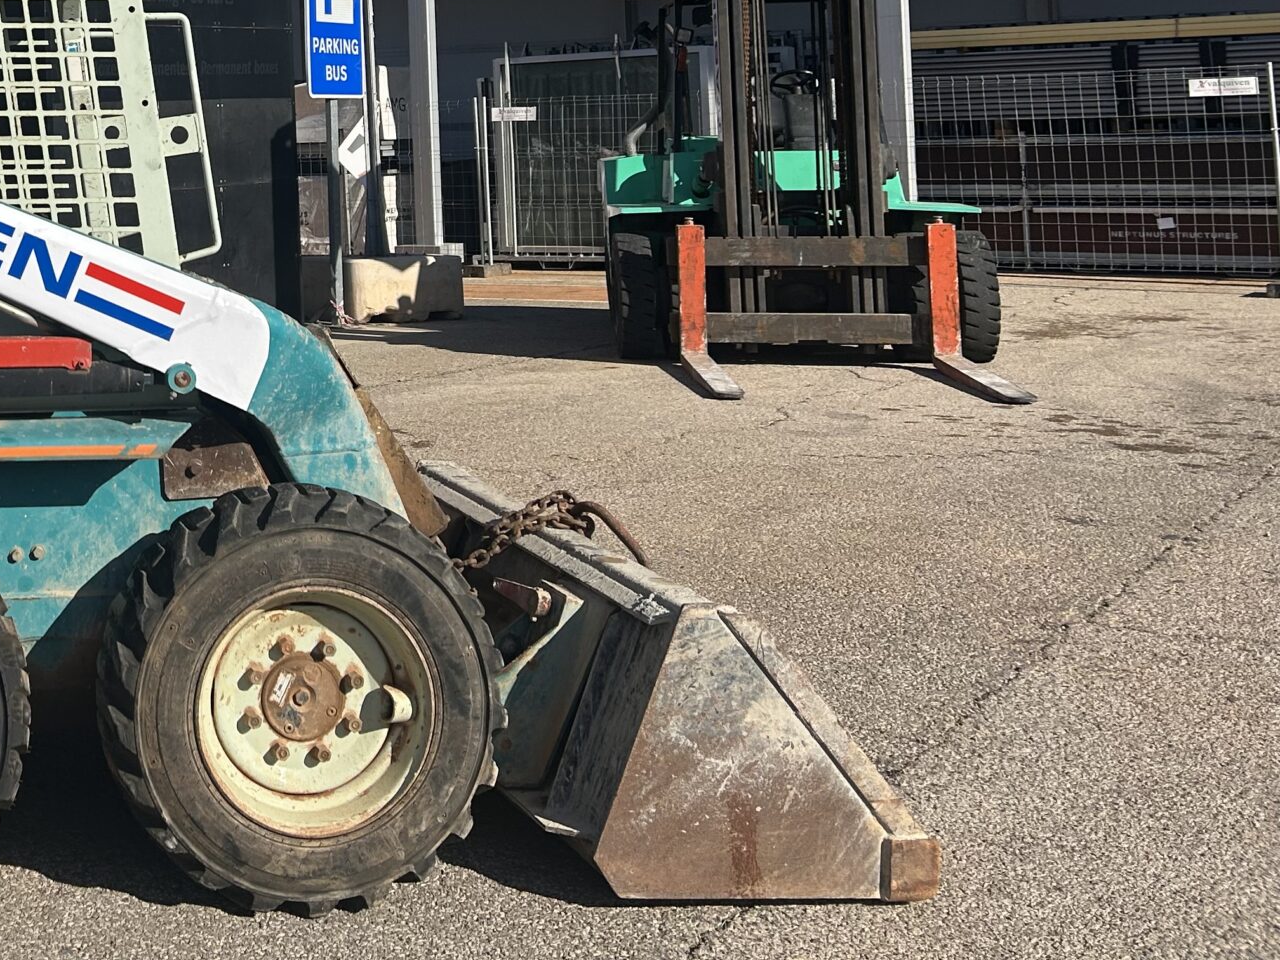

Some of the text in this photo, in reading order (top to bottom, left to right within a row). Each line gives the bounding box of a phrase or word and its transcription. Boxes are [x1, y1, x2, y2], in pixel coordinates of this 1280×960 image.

[312, 37, 359, 56] PARKING
[325, 64, 348, 82] BUS
[1111, 230, 1239, 240] NEPTUNUS STRUCTURES
